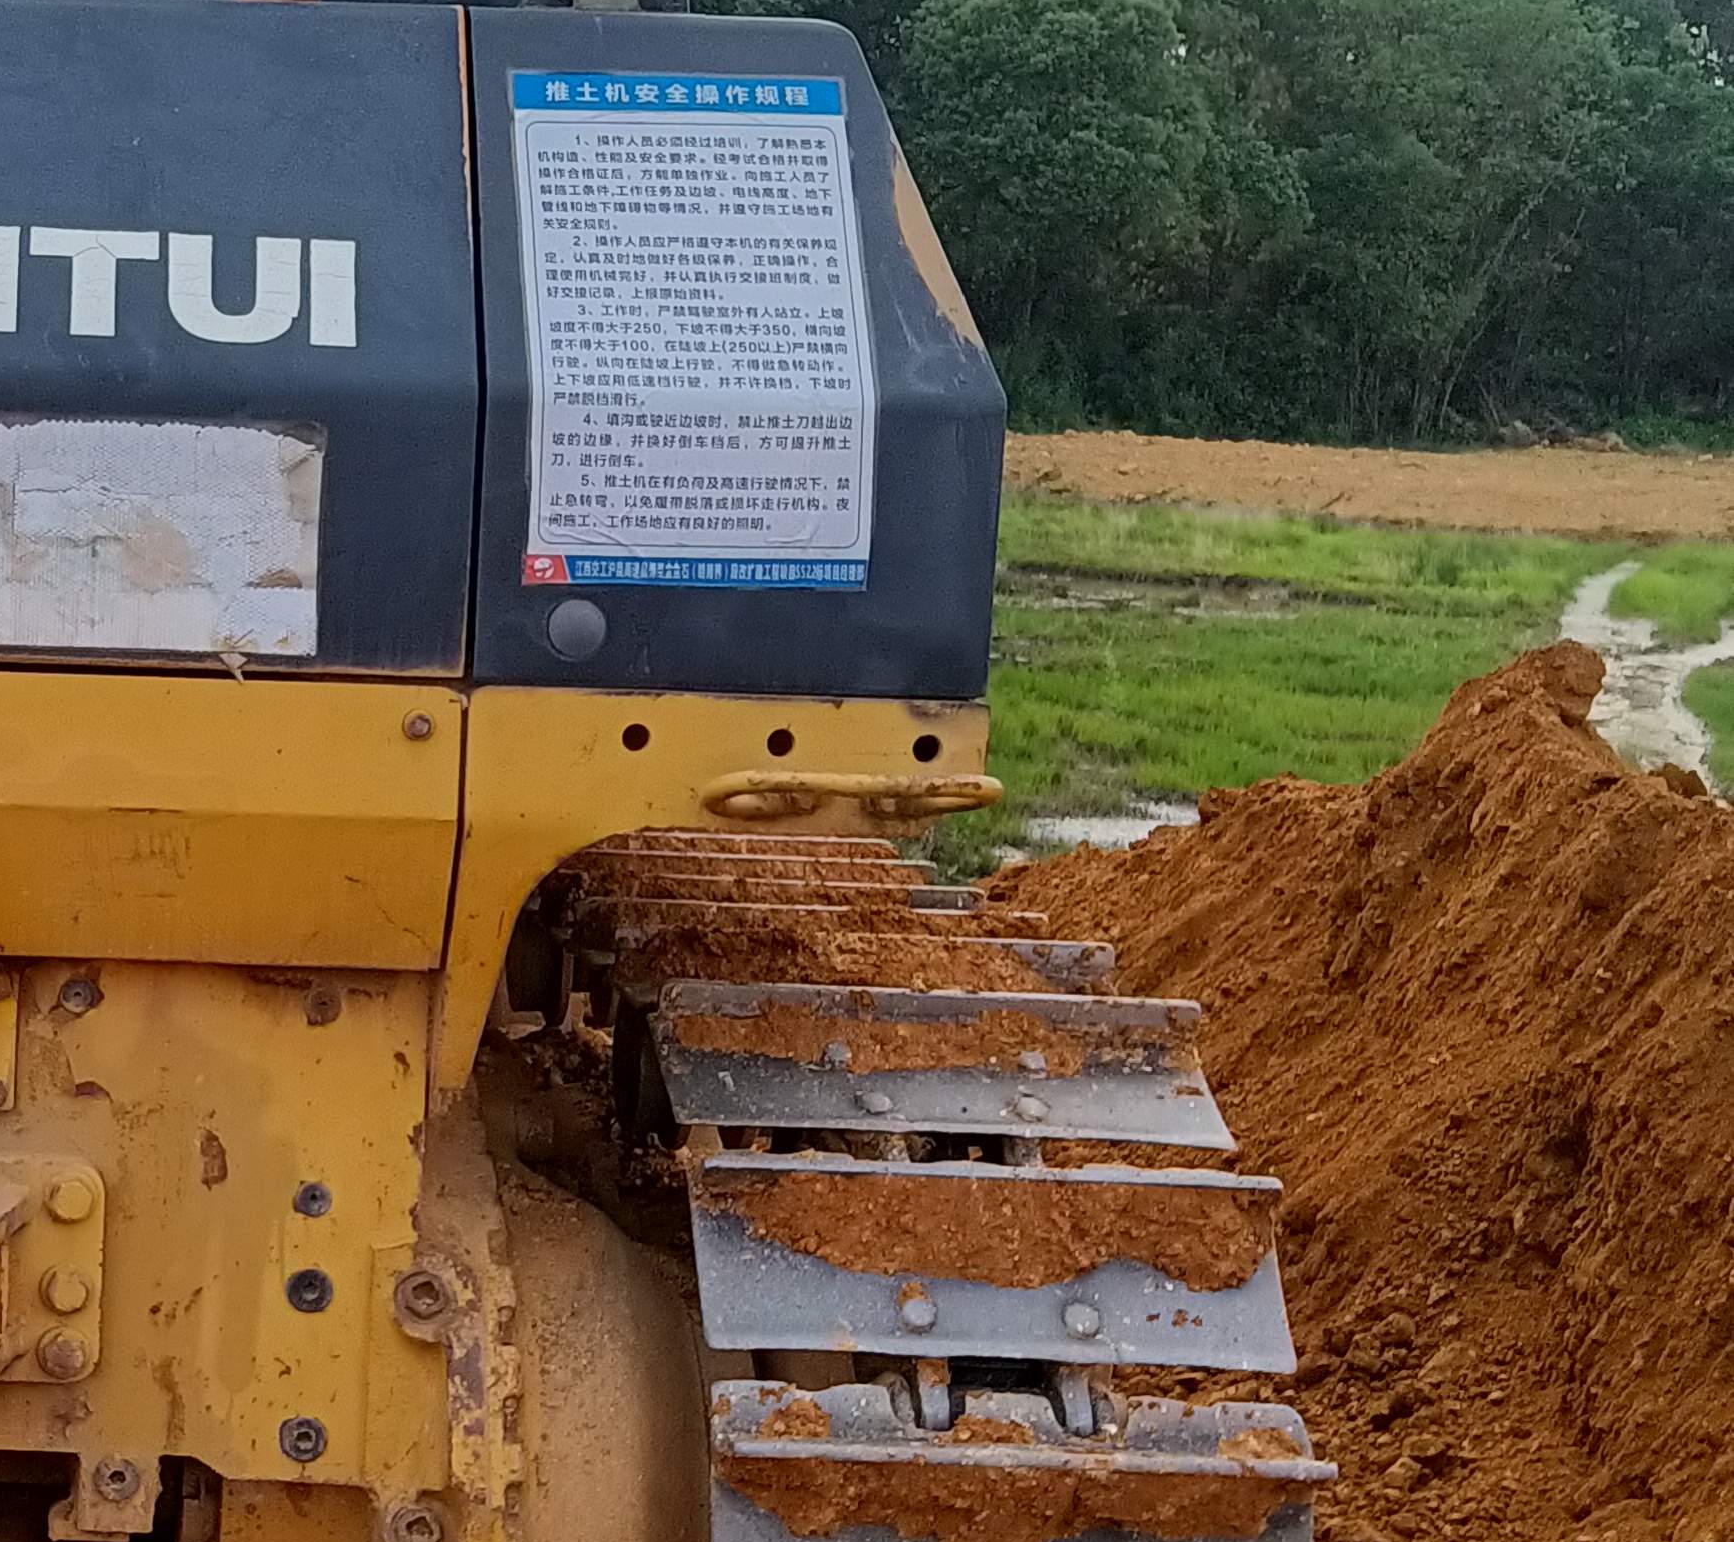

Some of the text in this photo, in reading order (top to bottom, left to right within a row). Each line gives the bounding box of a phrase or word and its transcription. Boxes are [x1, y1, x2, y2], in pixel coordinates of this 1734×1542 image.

[545, 81, 809, 106] 推土机安全操作规程
